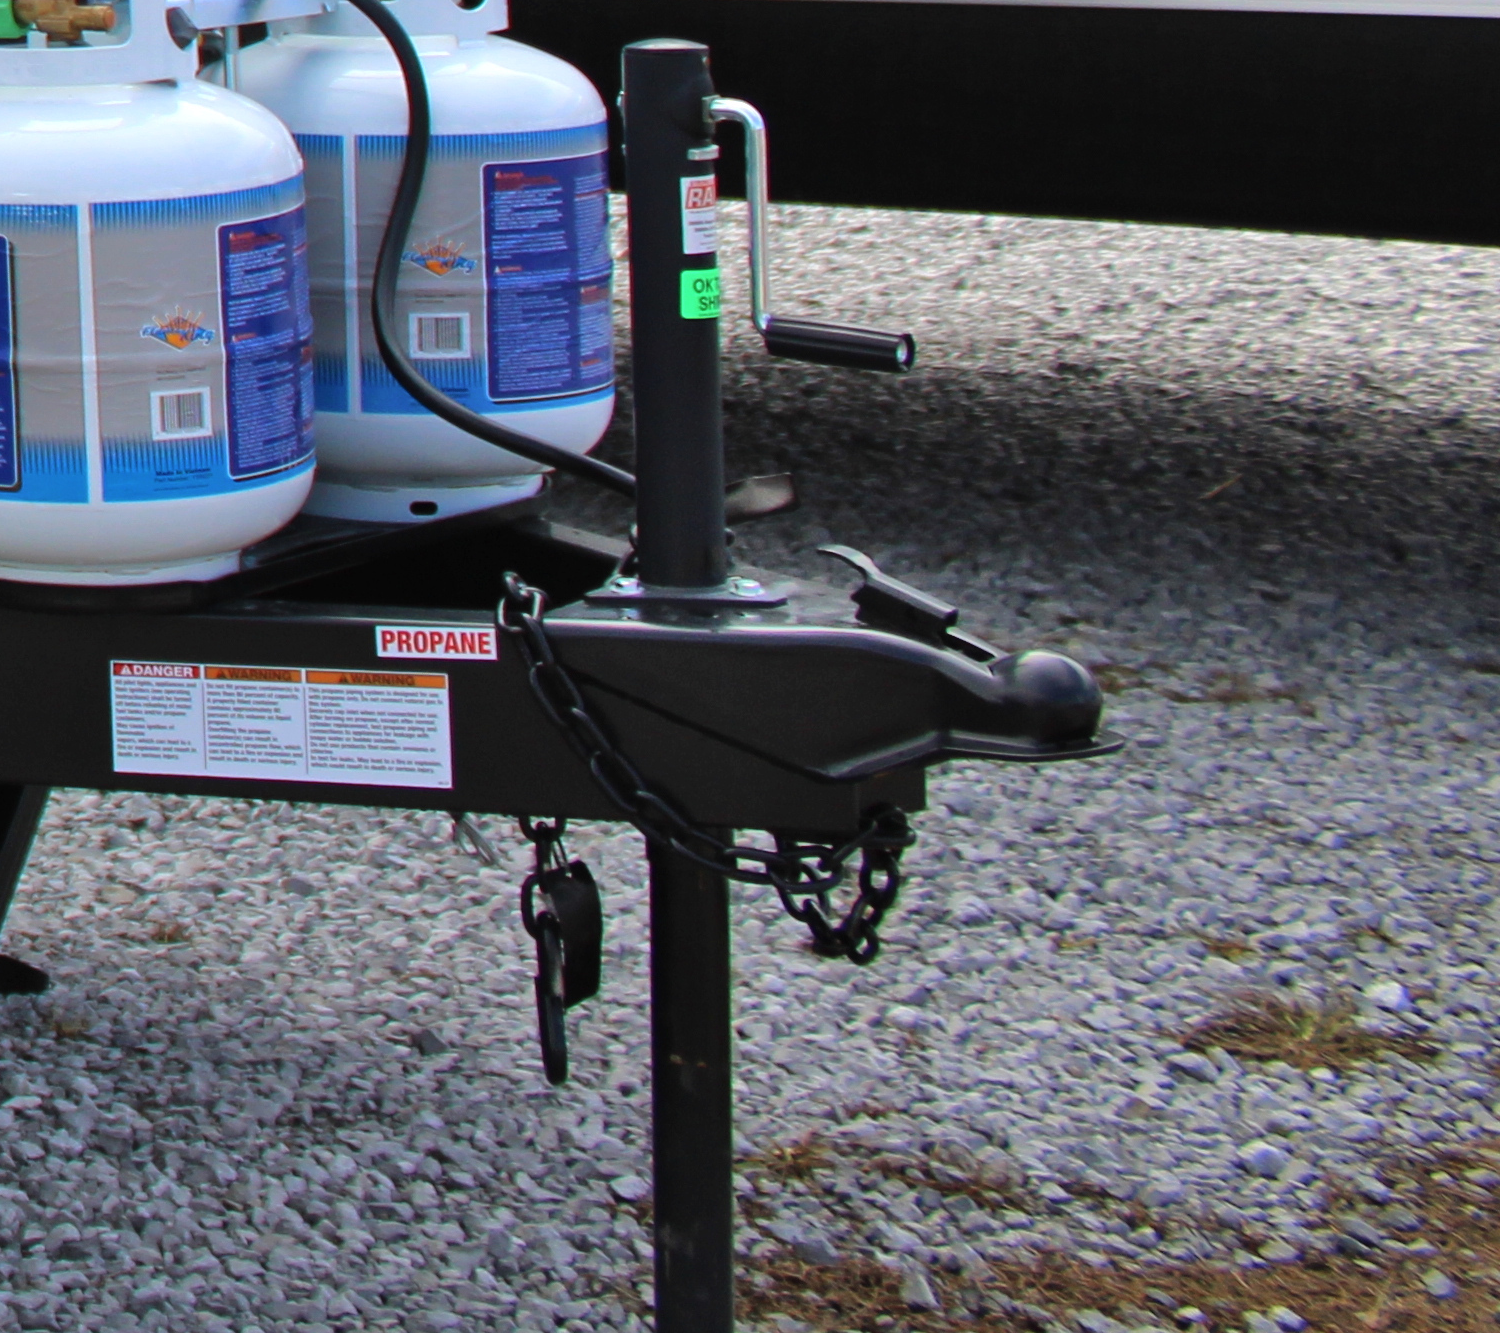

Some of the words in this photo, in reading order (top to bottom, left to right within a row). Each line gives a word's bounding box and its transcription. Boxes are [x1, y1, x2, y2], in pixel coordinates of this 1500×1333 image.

[381, 630, 492, 654] PROPANE
[133, 664, 194, 678] DANGER
[228, 669, 291, 682] WARNING
[348, 673, 415, 686] WARNING
